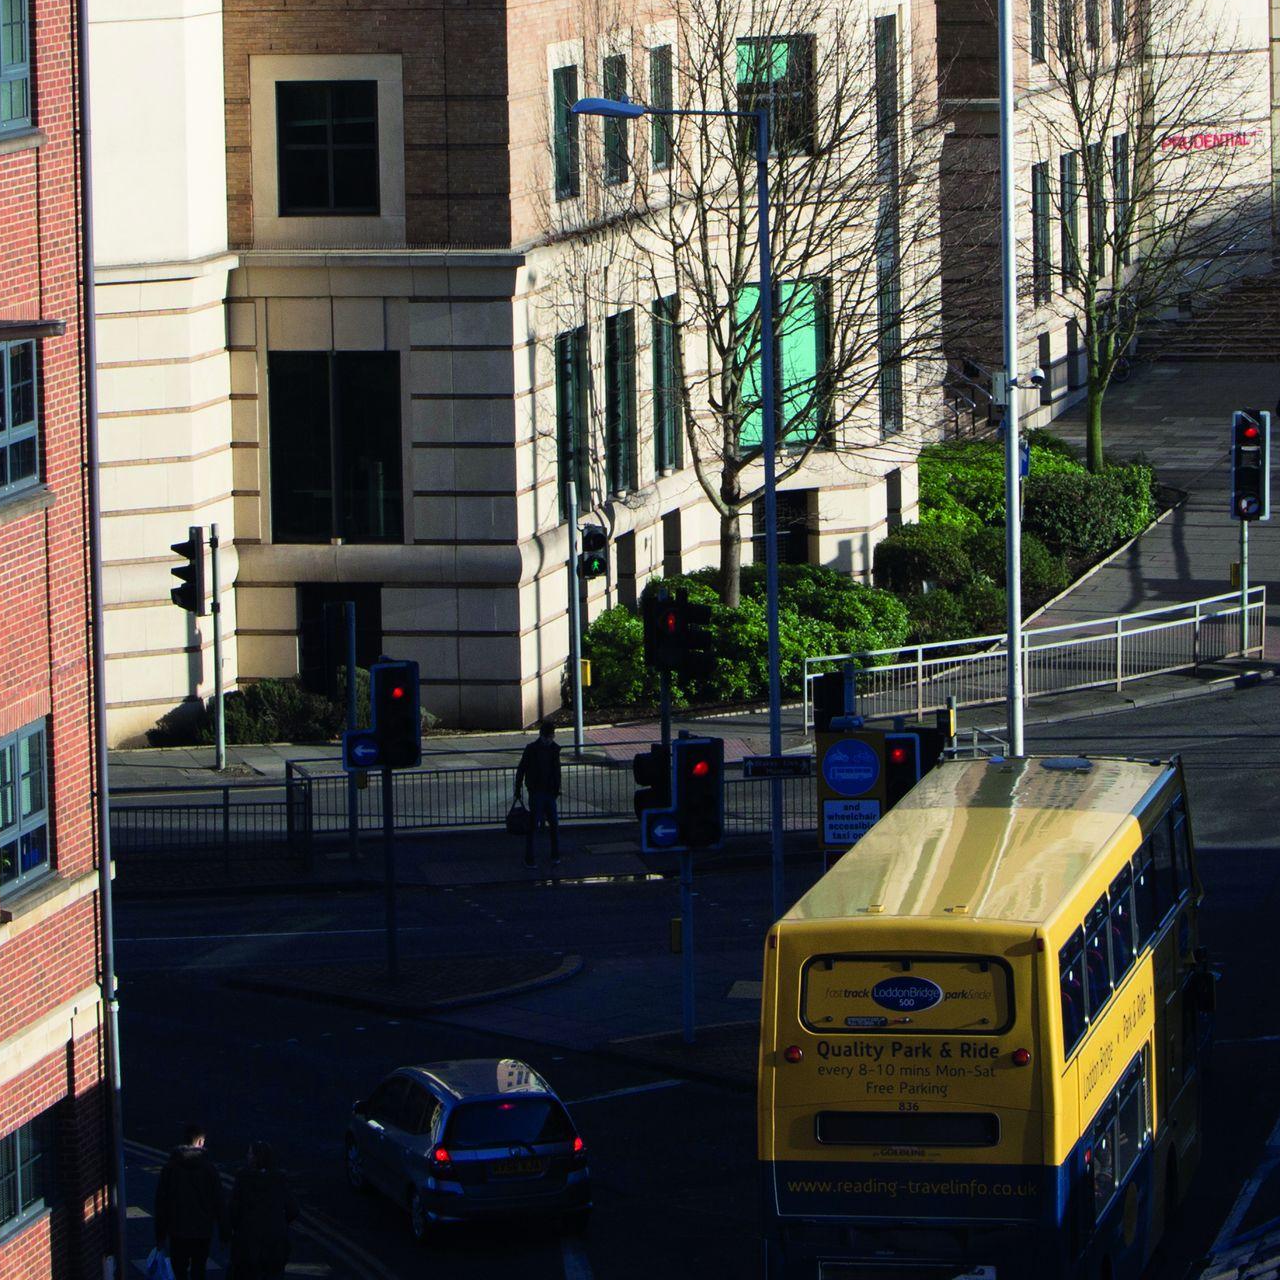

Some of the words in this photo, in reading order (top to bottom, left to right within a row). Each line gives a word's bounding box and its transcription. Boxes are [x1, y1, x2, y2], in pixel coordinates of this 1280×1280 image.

[843, 803, 860, 811] and
[828, 822, 874, 830] accessibl
[832, 831, 850, 840] taxi
[899, 998, 915, 1007] 500
[816, 1040, 884, 1061] Quality
[892, 1041, 932, 1058] Park
[939, 1042, 953, 1058] &
[960, 1042, 999, 1059] Ride
[817, 1065, 853, 1078] every
[899, 1064, 930, 1076] mins
[935, 1064, 996, 1077] Mon-Sat
[866, 1082, 894, 1094] Free
[899, 1081, 948, 1097] Parking
[898, 1102, 919, 1111] 836
[786, 1177, 1039, 1200] www.reading-travelinfo.co.uk
